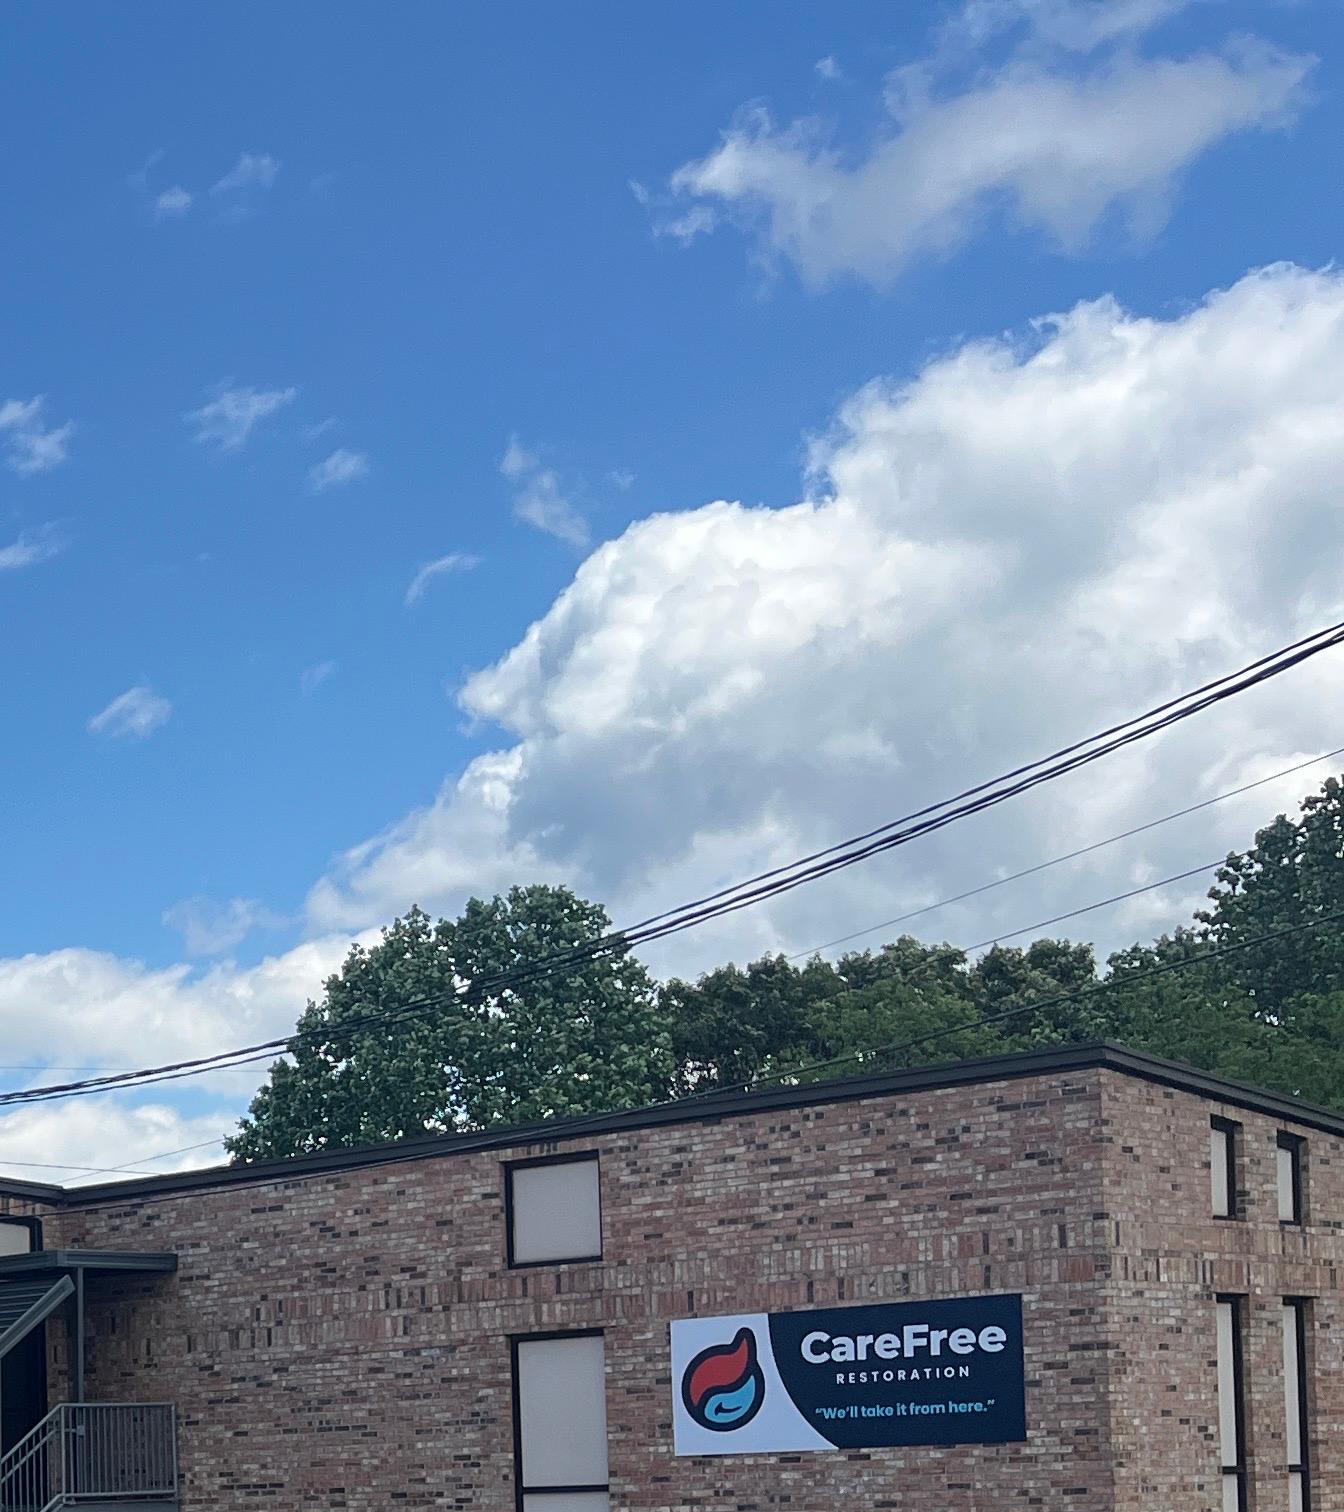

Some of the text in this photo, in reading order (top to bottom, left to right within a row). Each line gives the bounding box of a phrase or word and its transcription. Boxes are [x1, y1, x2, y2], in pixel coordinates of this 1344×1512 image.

[801, 1324, 1007, 1364] CareFree
[836, 1365, 970, 1384] RESTORATION
[815, 1399, 995, 1420] "We'll take it from here."
